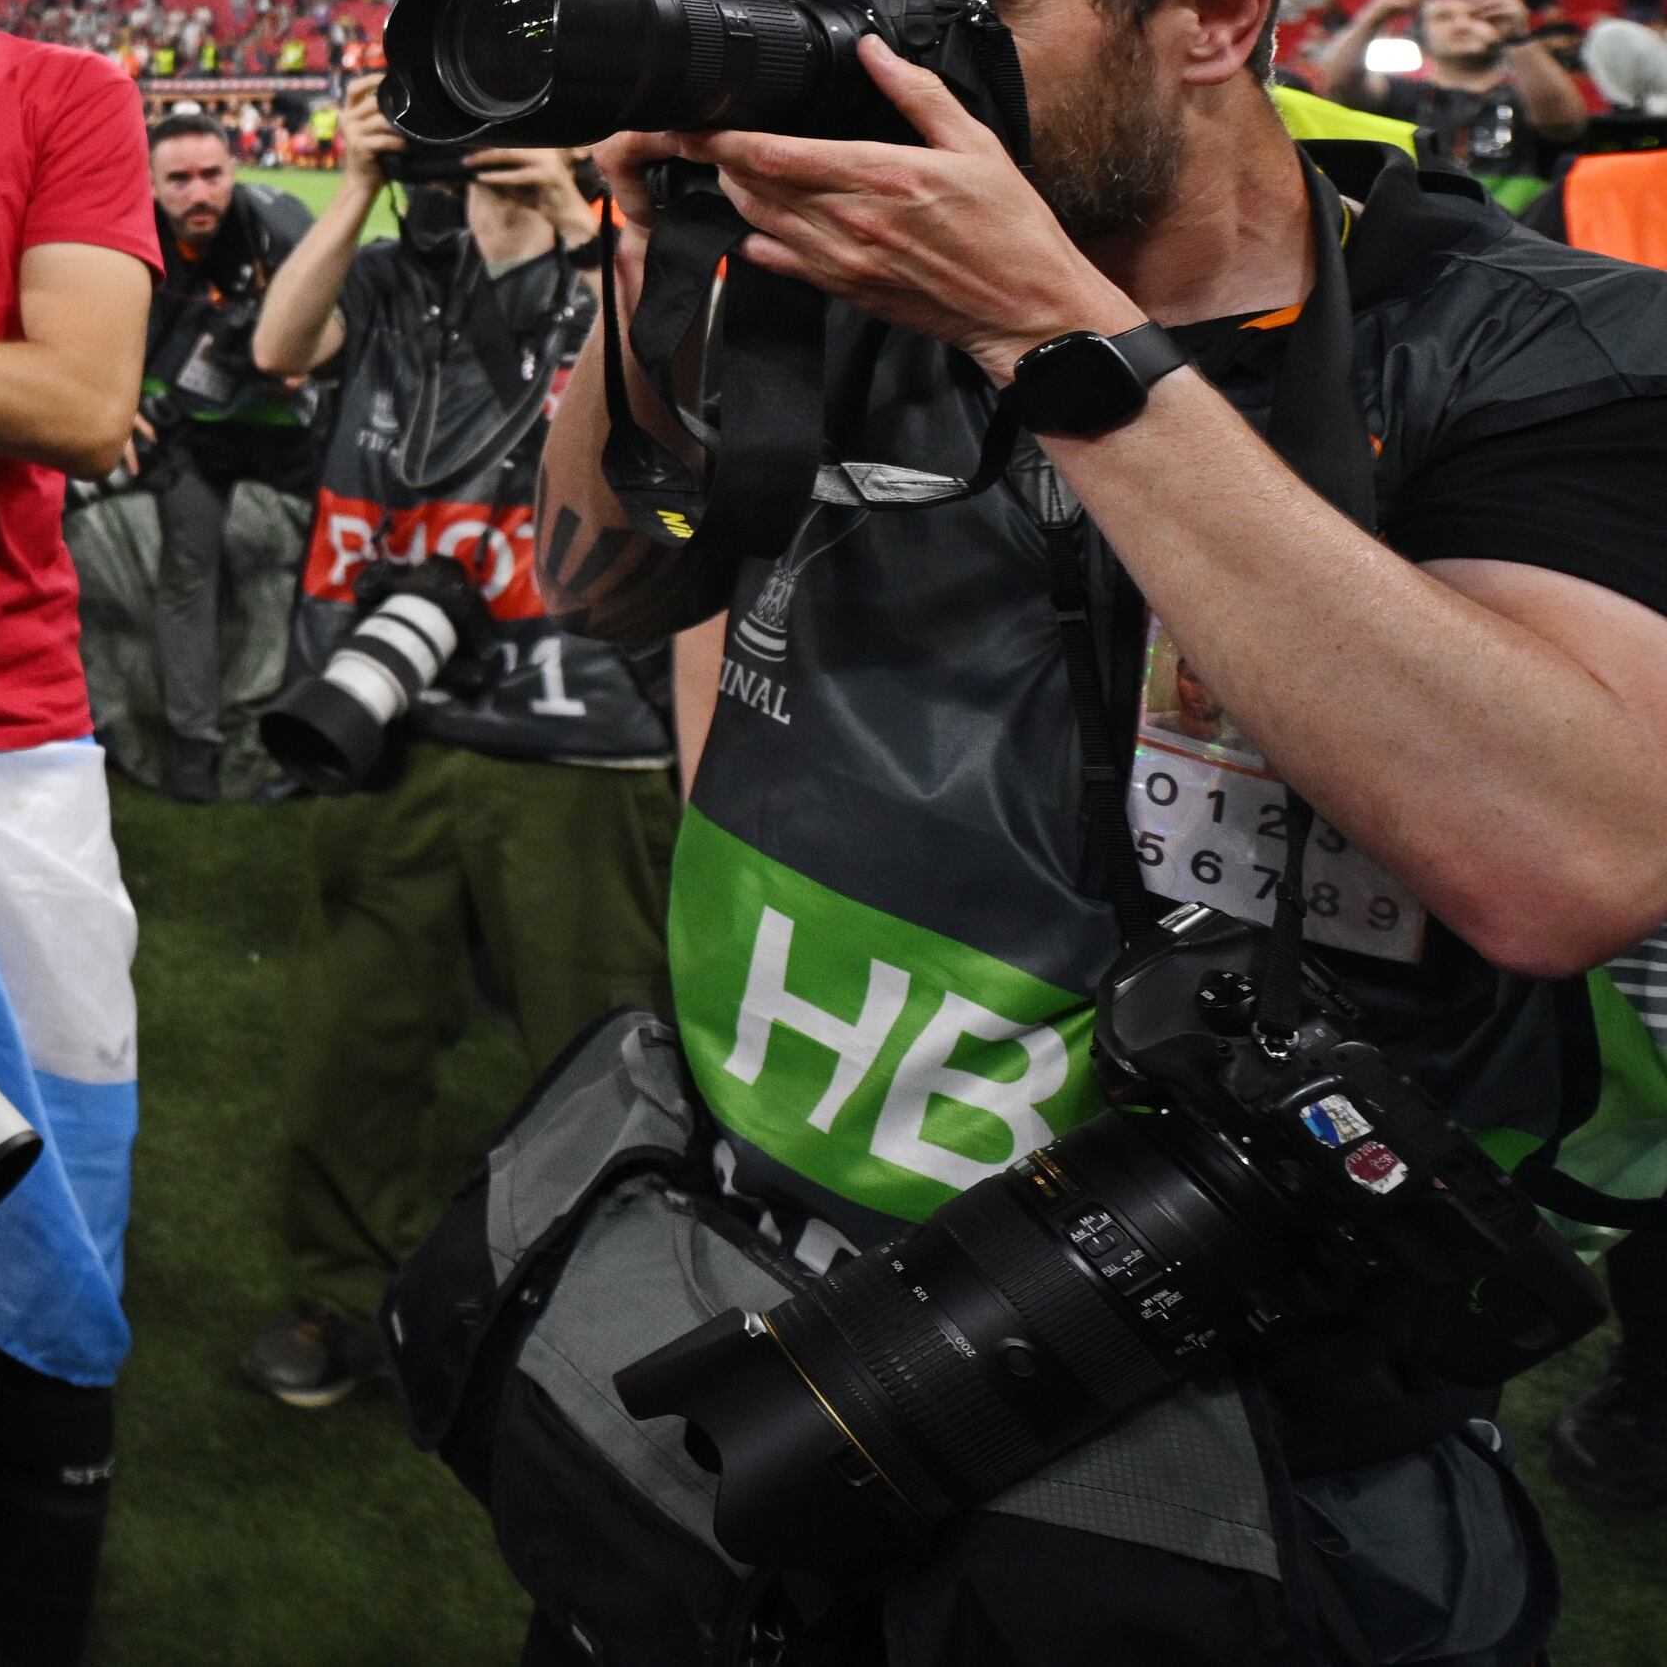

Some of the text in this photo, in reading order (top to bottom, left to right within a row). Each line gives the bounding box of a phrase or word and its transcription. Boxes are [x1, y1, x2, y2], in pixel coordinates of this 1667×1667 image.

[1145, 771, 1179, 807] 0
[1206, 789, 1227, 824] 1
[1256, 803, 1289, 841] 2
[1137, 830, 1401, 933] 5 6 7 8 9
[723, 904, 1069, 1193] HB
[911, 1285, 930, 1303] 135
[954, 1335, 978, 1359] 200
